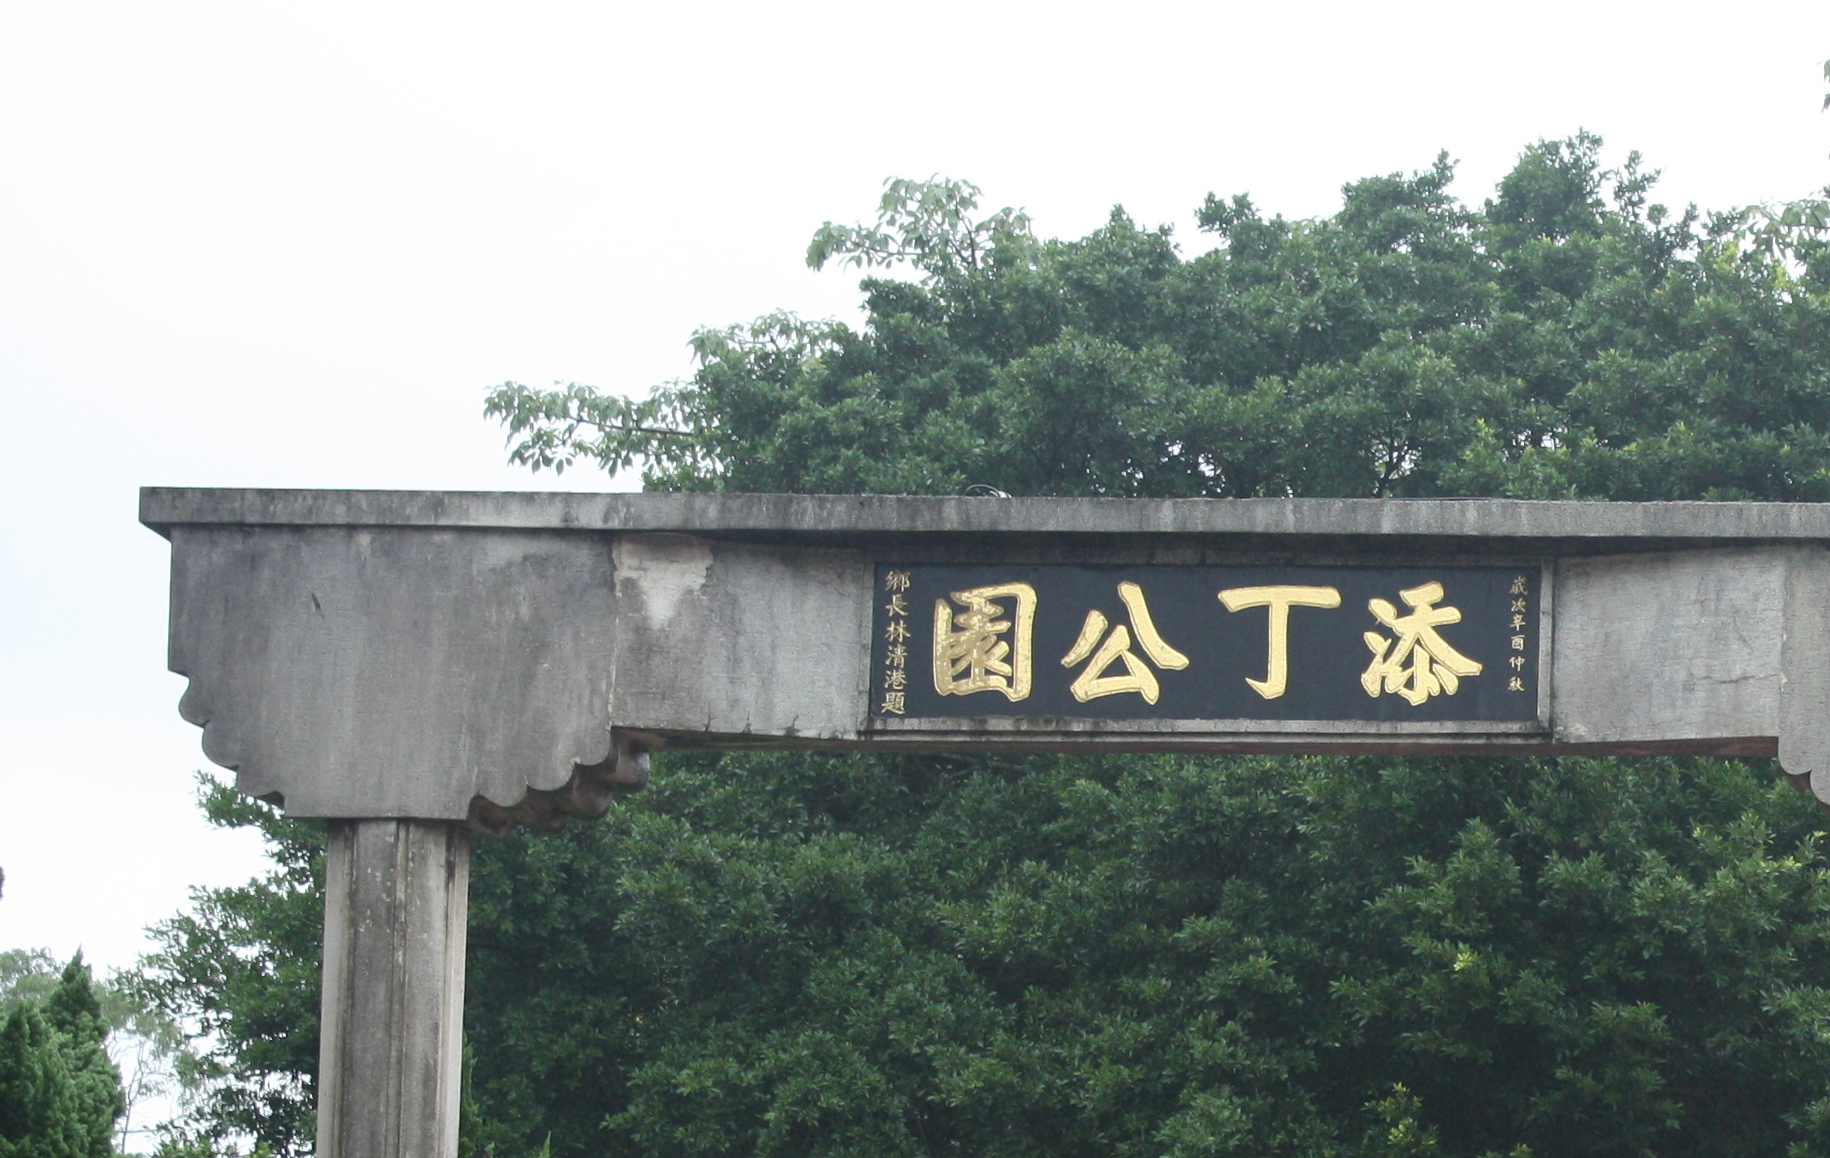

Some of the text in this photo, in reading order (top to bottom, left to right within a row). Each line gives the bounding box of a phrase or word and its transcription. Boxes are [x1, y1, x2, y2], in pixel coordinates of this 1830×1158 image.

[933, 579, 1483, 706] 添丁公園
[1507, 575, 1528, 693] 歲次辛酉仲秋
